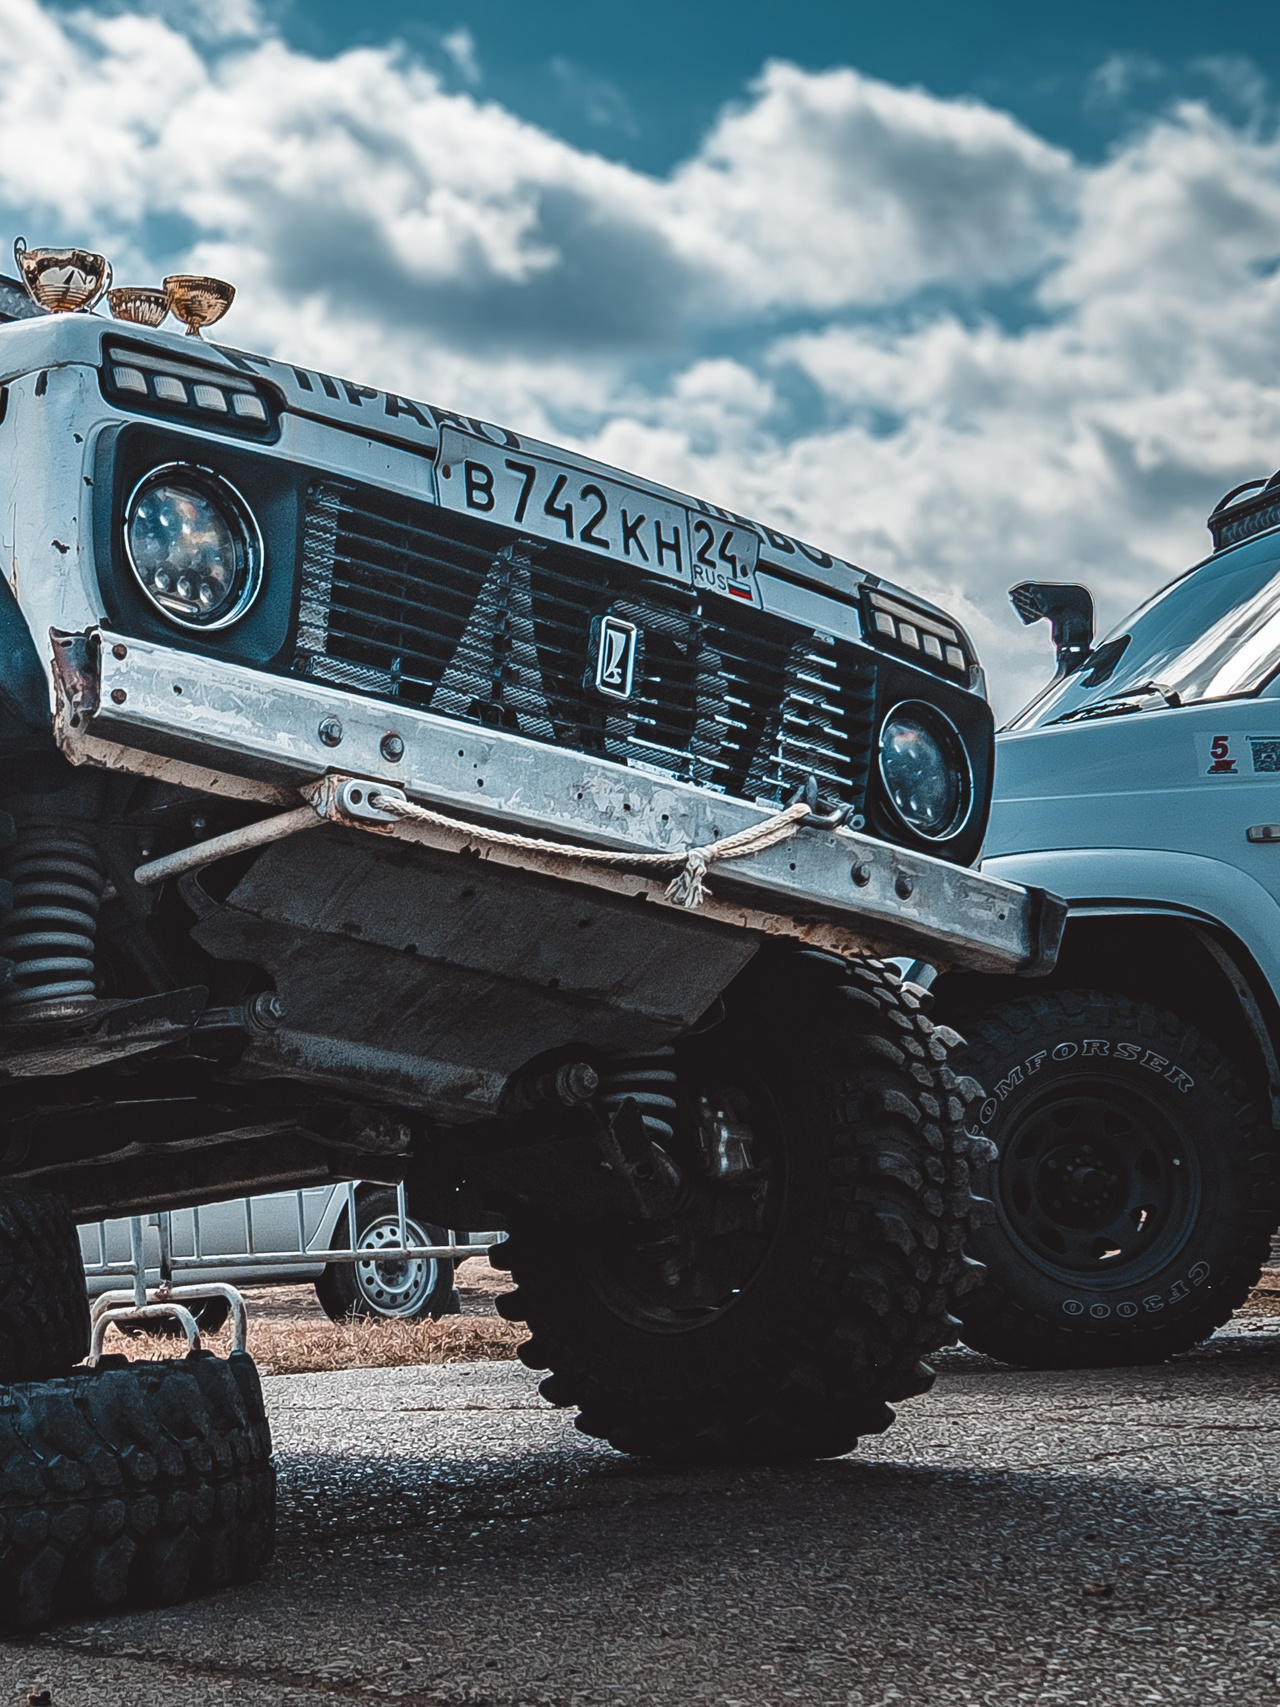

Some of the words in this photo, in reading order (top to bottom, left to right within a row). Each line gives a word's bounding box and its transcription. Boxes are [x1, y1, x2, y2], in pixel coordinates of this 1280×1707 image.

[693, 520, 738, 579] 24
[694, 563, 727, 591] RUS
[1210, 735, 1229, 760] 5
[1062, 1261, 1210, 1319] CF3000
